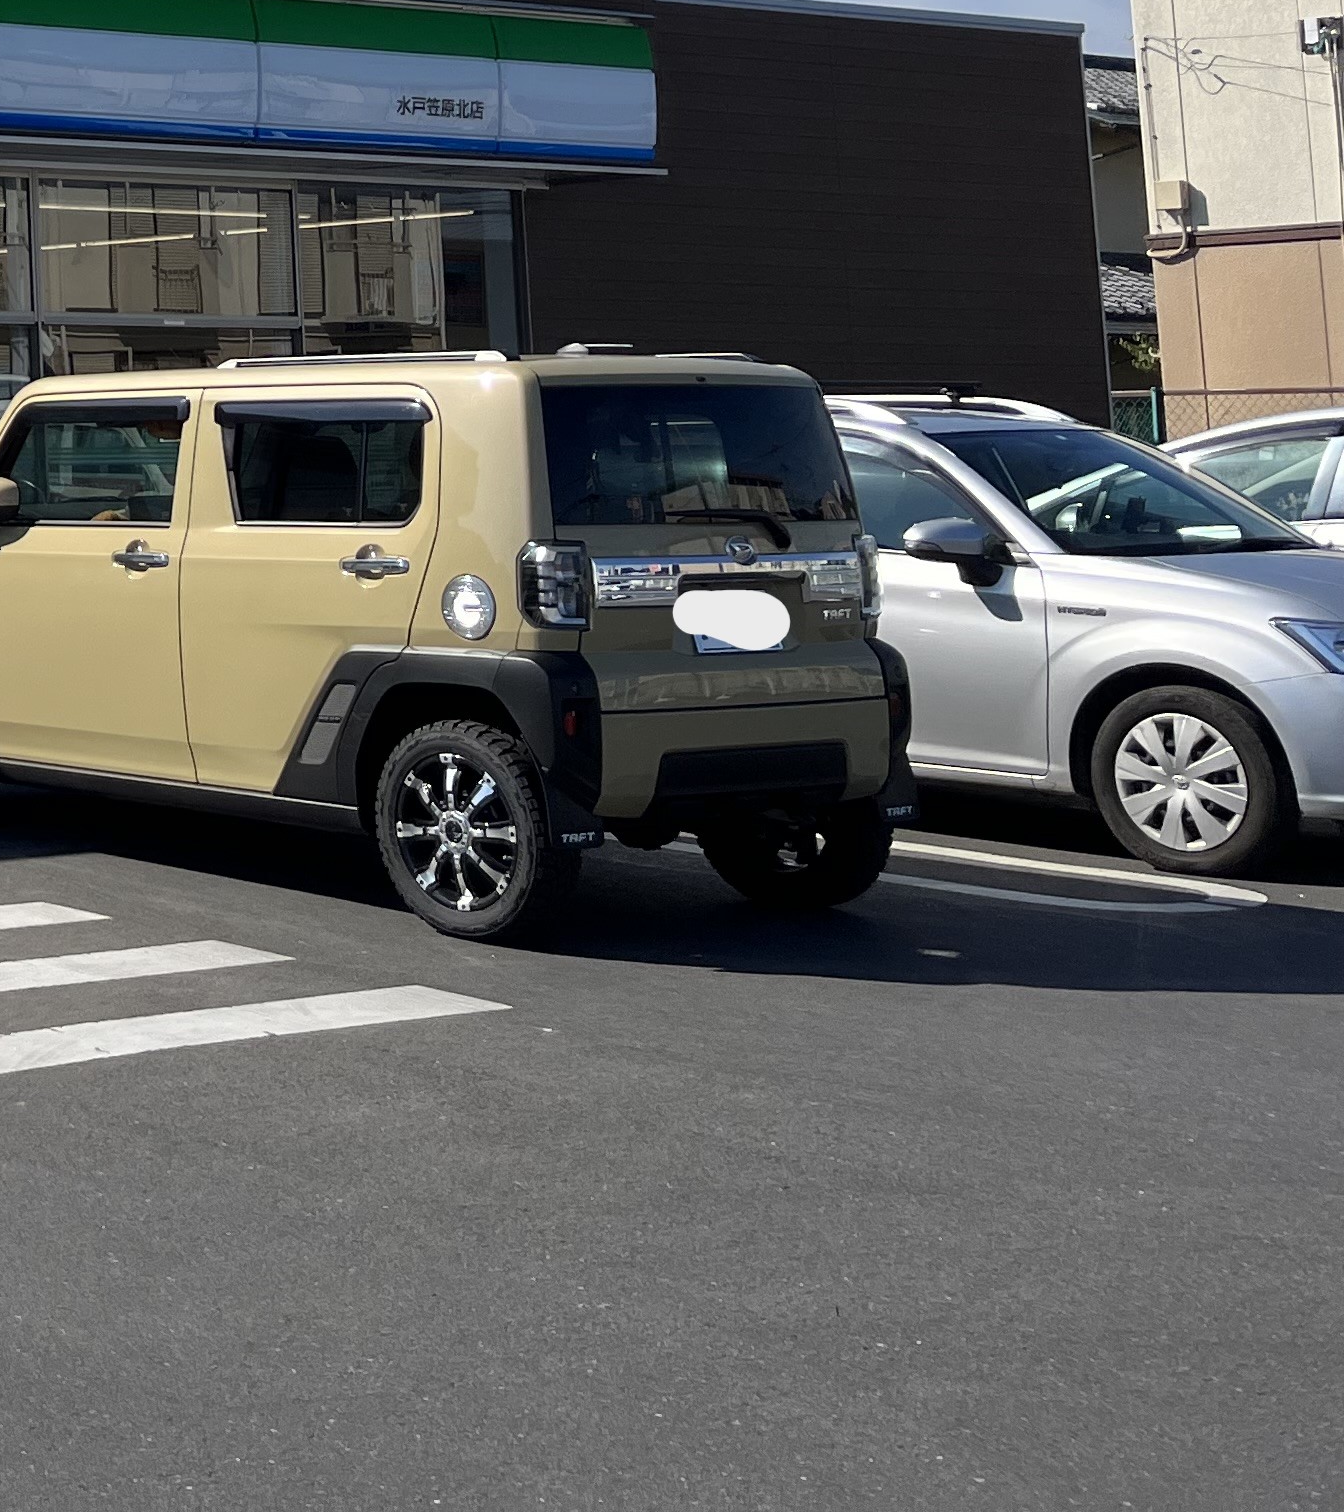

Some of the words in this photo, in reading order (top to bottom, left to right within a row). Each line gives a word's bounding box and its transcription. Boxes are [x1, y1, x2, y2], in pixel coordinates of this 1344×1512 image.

[396, 95, 485, 120] 水戸笠原北店
[822, 606, 853, 621] TAFT
[886, 805, 914, 818] TAFT
[560, 830, 596, 844] TAFT
